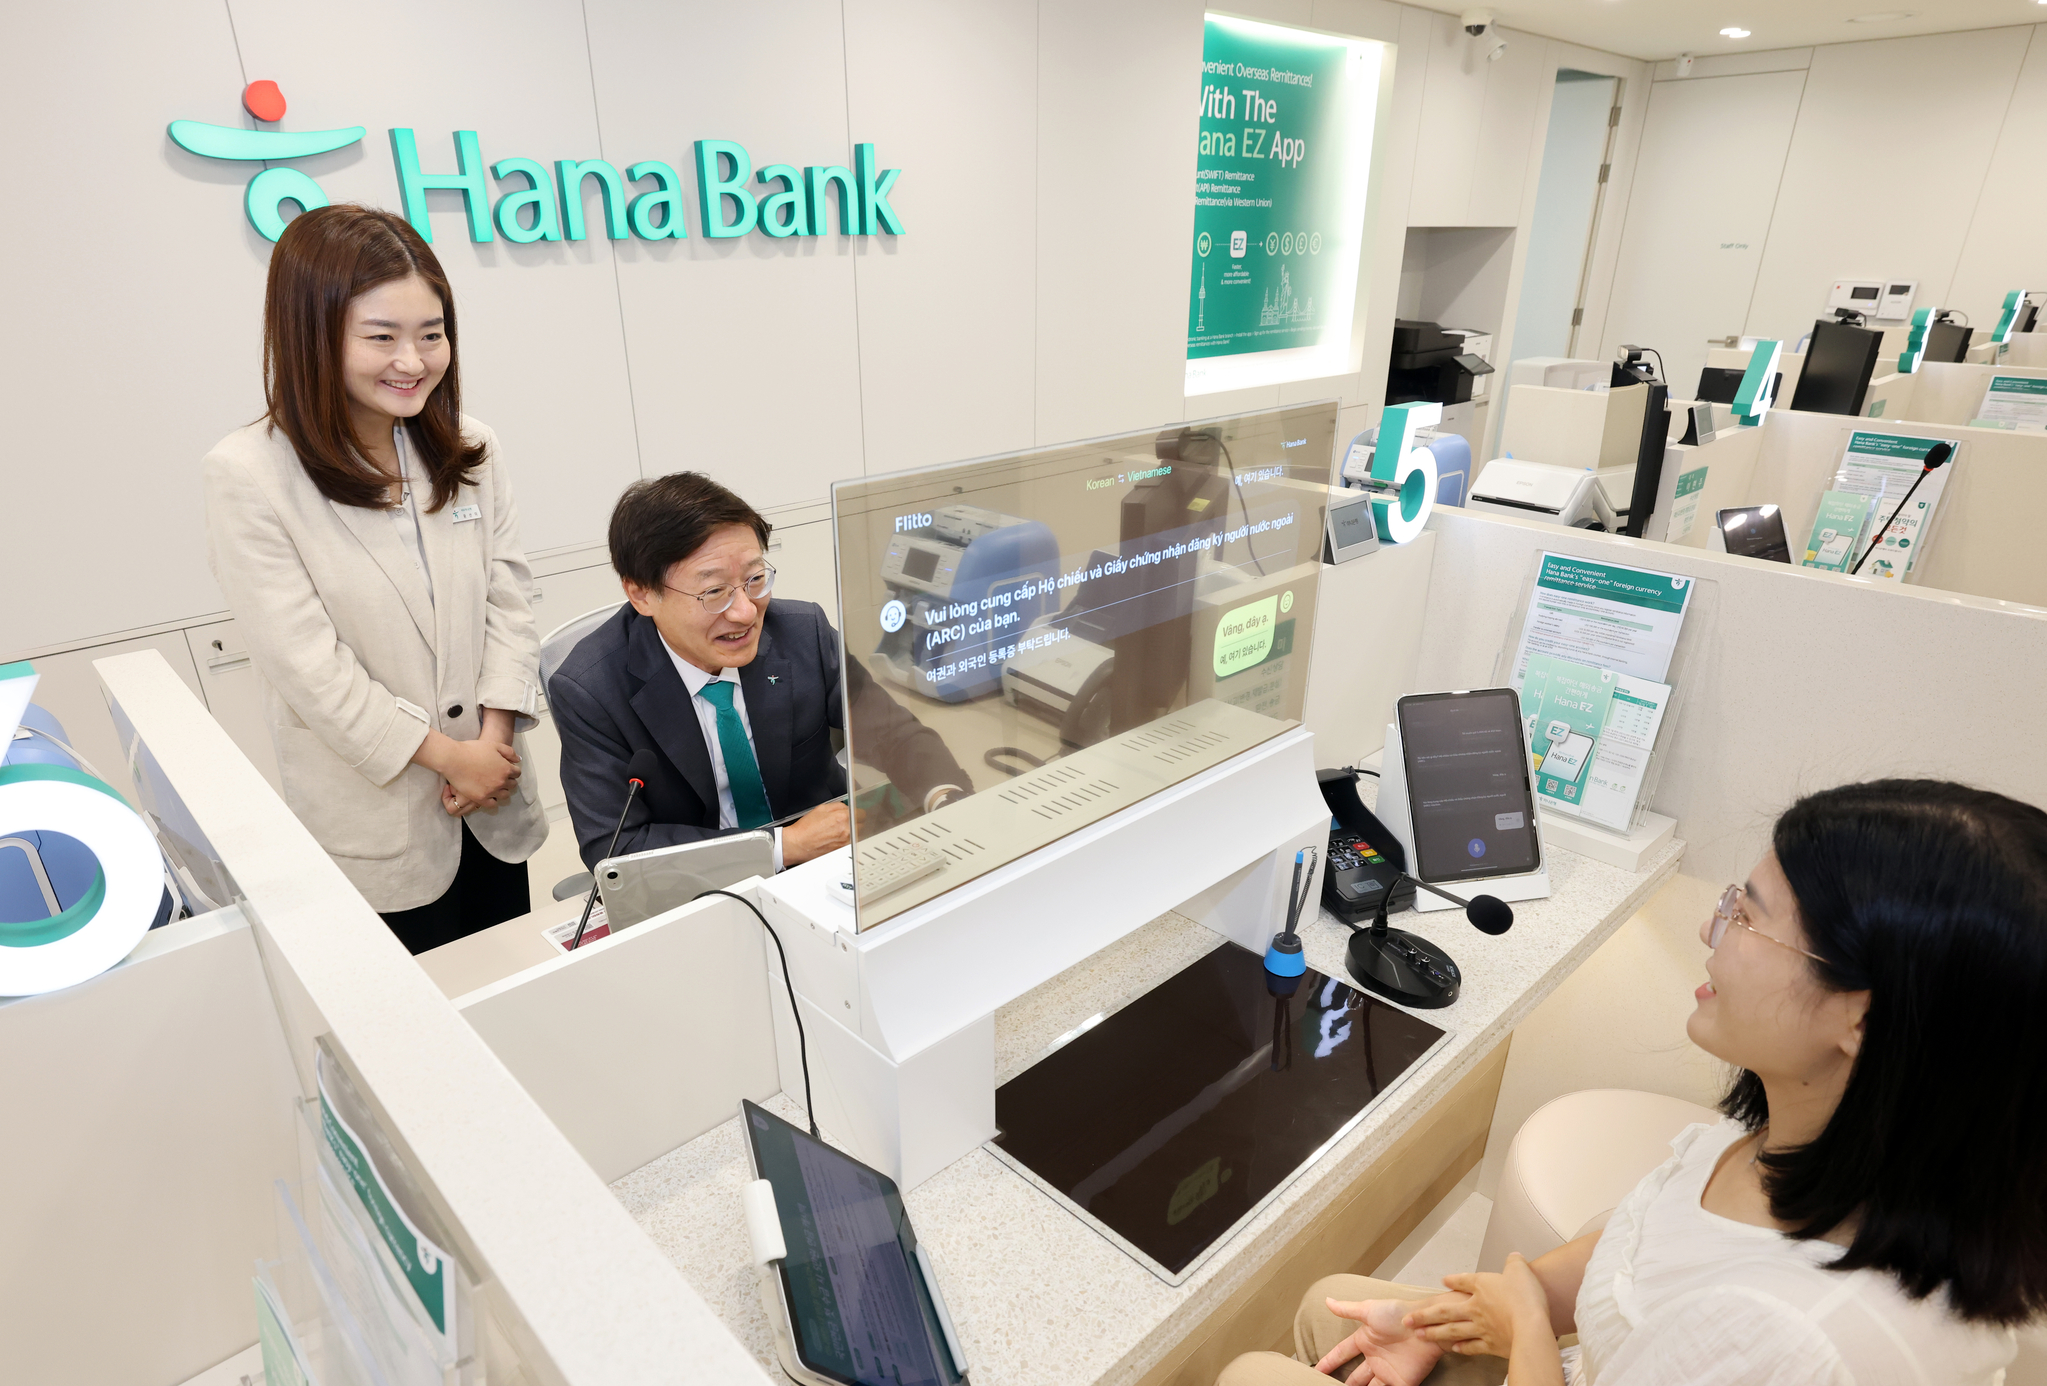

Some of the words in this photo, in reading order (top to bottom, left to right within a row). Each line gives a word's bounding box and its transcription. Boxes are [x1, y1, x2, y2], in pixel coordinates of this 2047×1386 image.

[1236, 63, 1269, 80] Overseas
[1270, 68, 1313, 87] Remittances!
[1242, 90, 1277, 123] The
[1242, 128, 1266, 158] EZ
[1269, 131, 1305, 168] App
[388, 127, 687, 243] Hana
[695, 139, 906, 239] Bank
[1225, 171, 1255, 181] Remittance
[1211, 184, 1241, 194] Remittance
[1234, 197, 1255, 207] Western
[1256, 198, 1273, 208] Union)
[1233, 238, 1244, 250] EZ
[1731, 340, 1784, 427] 4
[1086, 475, 1114, 491] Korean
[1127, 465, 1172, 482] Vietnamese
[1244, 470, 1257, 484] 여기
[1258, 465, 1284, 482] 있습니다.
[1370, 401, 1443, 544] 5
[895, 512, 932, 533] Flitto
[1826, 513, 1843, 521] Hana
[925, 606, 947, 625] Vui
[949, 600, 978, 620] lòng
[980, 591, 1012, 610] cung
[1014, 581, 1036, 602] cấp
[1038, 577, 1055, 595] Hộ
[1057, 566, 1088, 589] chiếu
[1090, 563, 1103, 578] và
[1104, 554, 1128, 577] Giấy
[1162, 542, 1187, 559] nhận
[1188, 535, 1212, 554] đăng
[1212, 531, 1224, 547] ký
[1271, 511, 1294, 532] ngoài
[1547, 562, 1559, 571] Easy
[1572, 566, 1606, 578] Convenient
[1545, 568, 1560, 576] Hana
[1560, 571, 1579, 580] Bank's
[1613, 581, 1635, 591] foreign
[1635, 585, 1663, 597] currency
[1575, 581, 1597, 590] service
[926, 624, 966, 650] (ARC)
[968, 617, 992, 635] của
[994, 611, 1021, 629] bạn.
[1222, 621, 1244, 637] Vâng,
[1246, 615, 1261, 629] đây
[926, 663, 956, 682] 여권과
[958, 652, 987, 672] 외국인
[988, 644, 1016, 665] 등록증
[1017, 627, 1071, 654] 부탁드립니다.
[1229, 648, 1241, 660] 여기
[1242, 639, 1267, 657] 있습니다.
[1554, 695, 1578, 709] Hana
[1580, 702, 1594, 713] EZ
[1550, 725, 1565, 738] EZ
[1551, 752, 1568, 763] Hana
[1567, 757, 1578, 766] EZ
